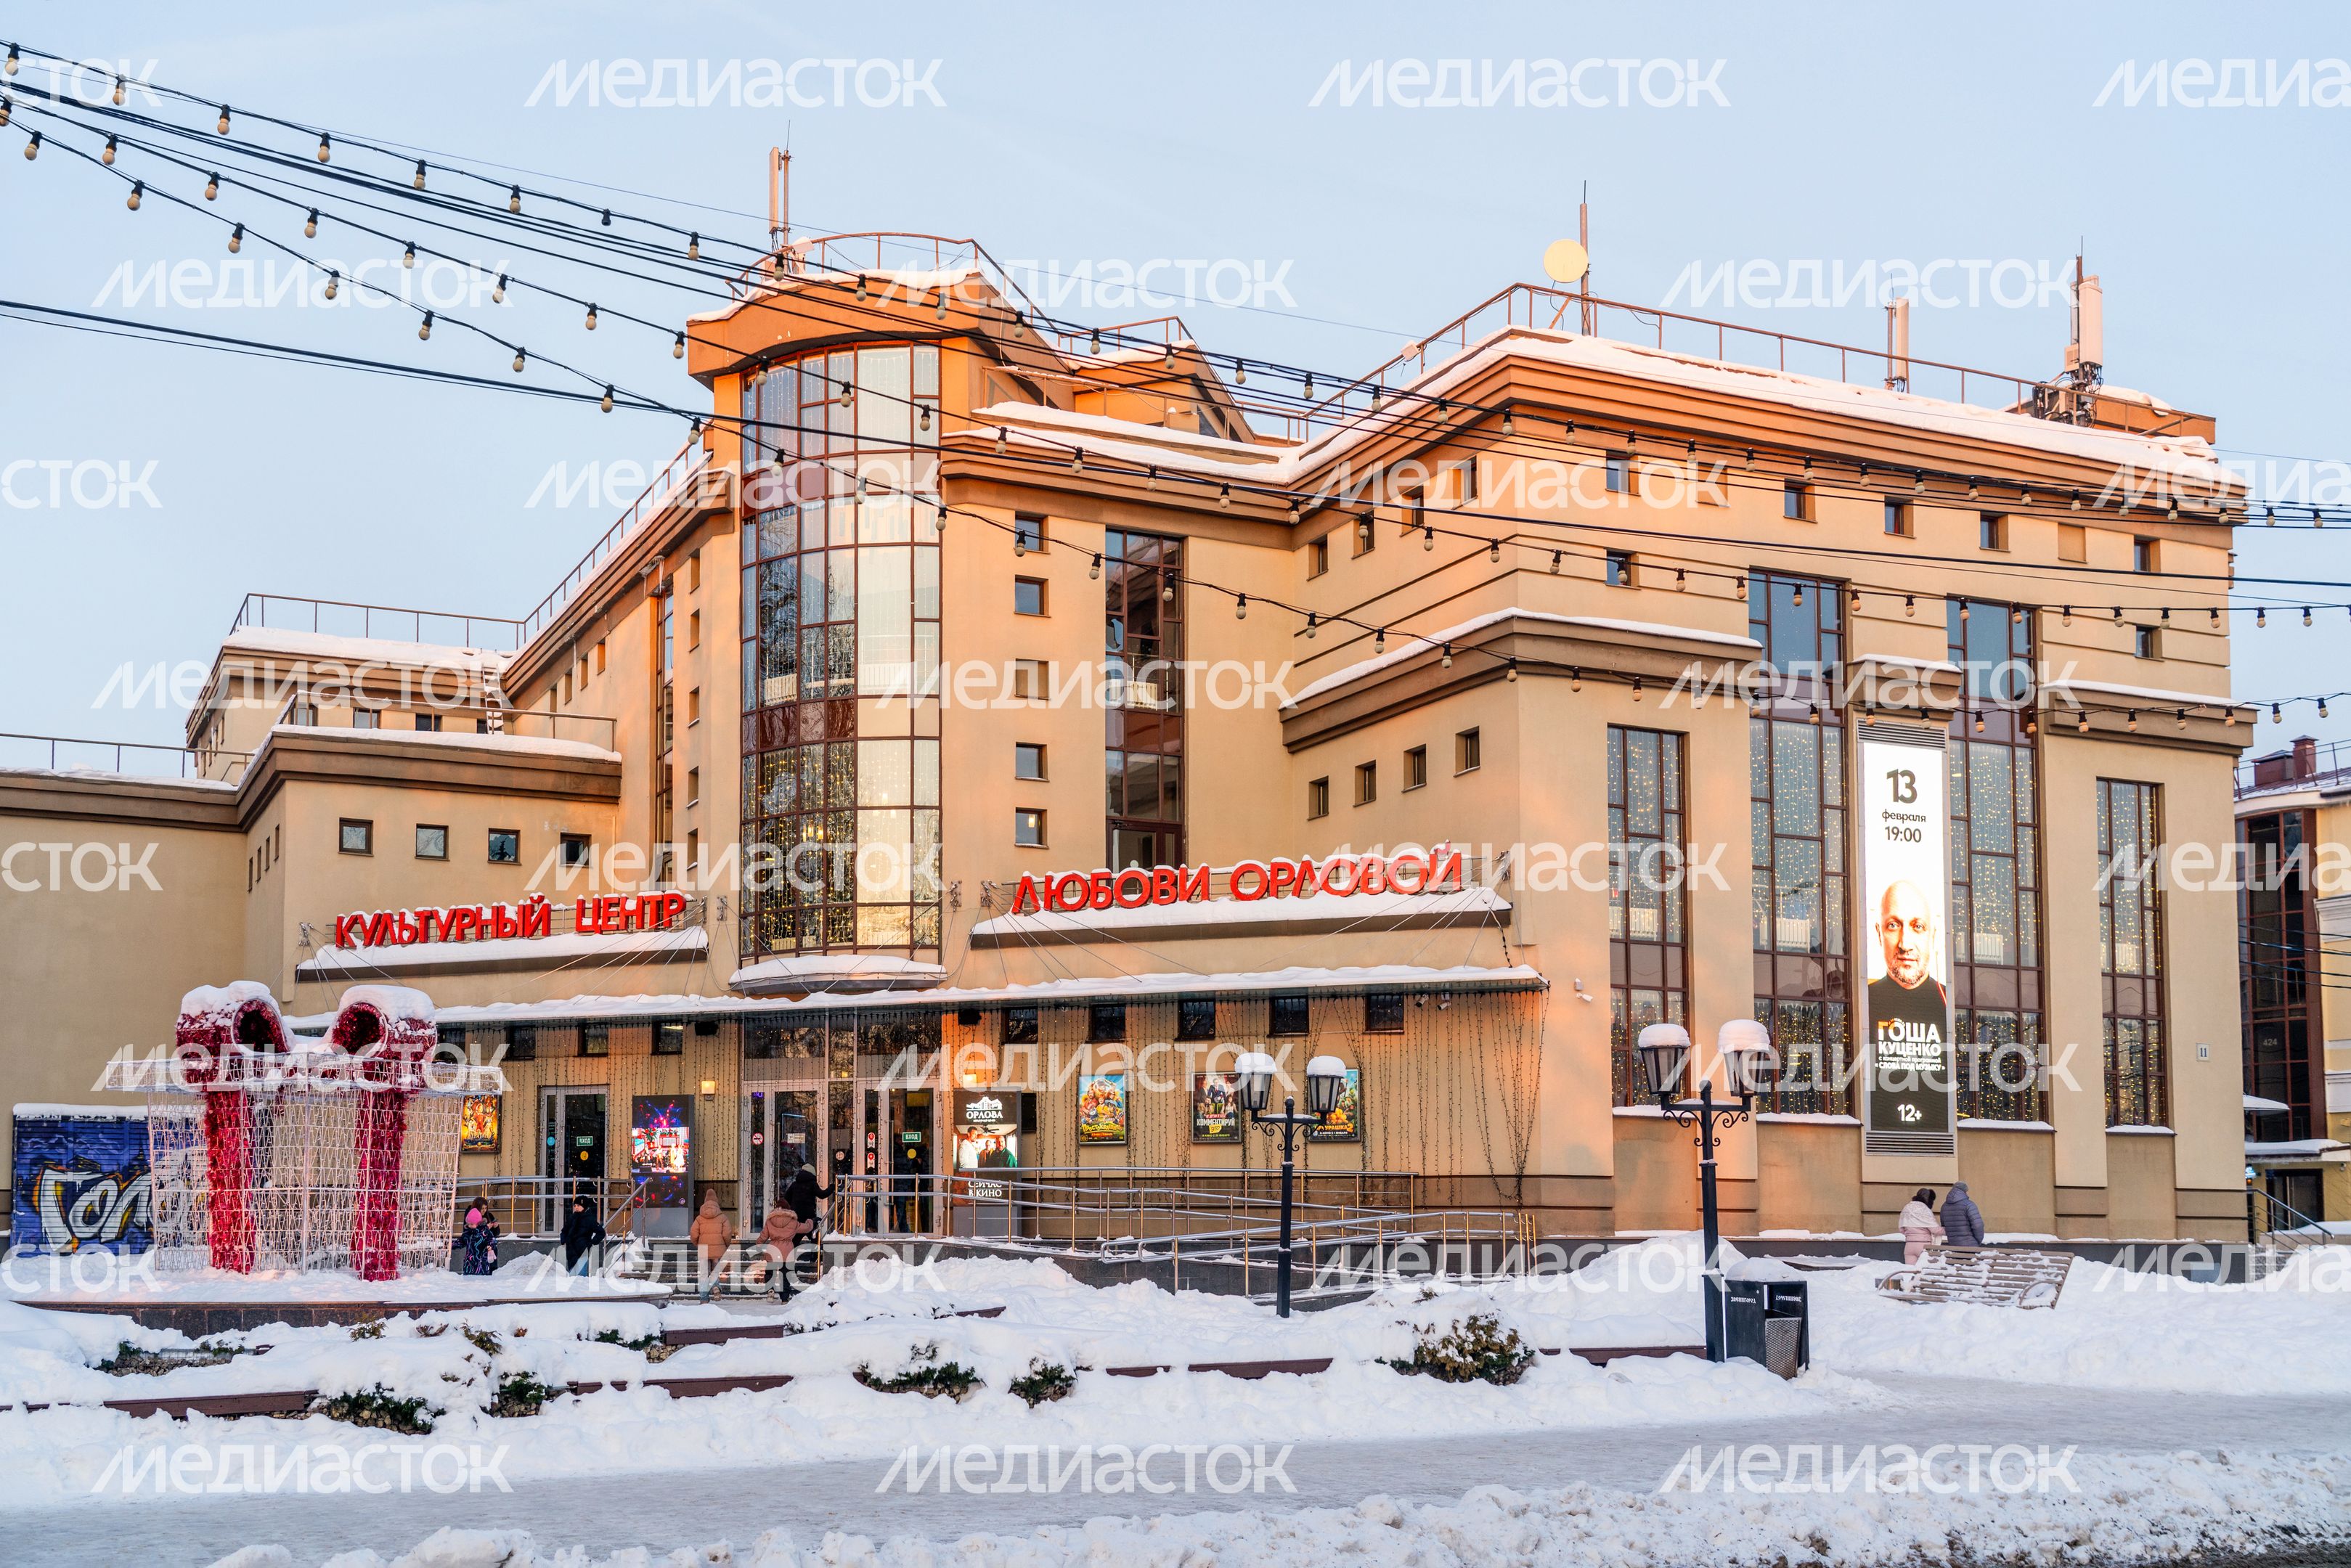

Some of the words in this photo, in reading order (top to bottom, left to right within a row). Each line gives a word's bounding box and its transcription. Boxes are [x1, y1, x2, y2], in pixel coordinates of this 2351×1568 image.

[1886, 769, 1918, 804] 13
[1882, 809, 1926, 824] февраля
[1885, 826, 1922, 843] 19:00
[1011, 865, 1210, 914] ЛЮБОВИ
[1229, 842, 1462, 901] ОРЛОВОЙ
[335, 894, 552, 949] КУЛЬТУРНЫЙ
[575, 892, 687, 935] ЦЕНТР
[1878, 1020, 1941, 1043] ГОША
[1878, 1041, 1941, 1057] КУЦЕНКО
[2200, 1048, 2207, 1058] 11
[1901, 1062, 1915, 1071] ПОД
[966, 1111, 1003, 1119] ОРЛОВА
[1897, 1103, 1923, 1122] 12+
[1197, 1117, 1235, 1126] КОММЕНТИРУЙ
